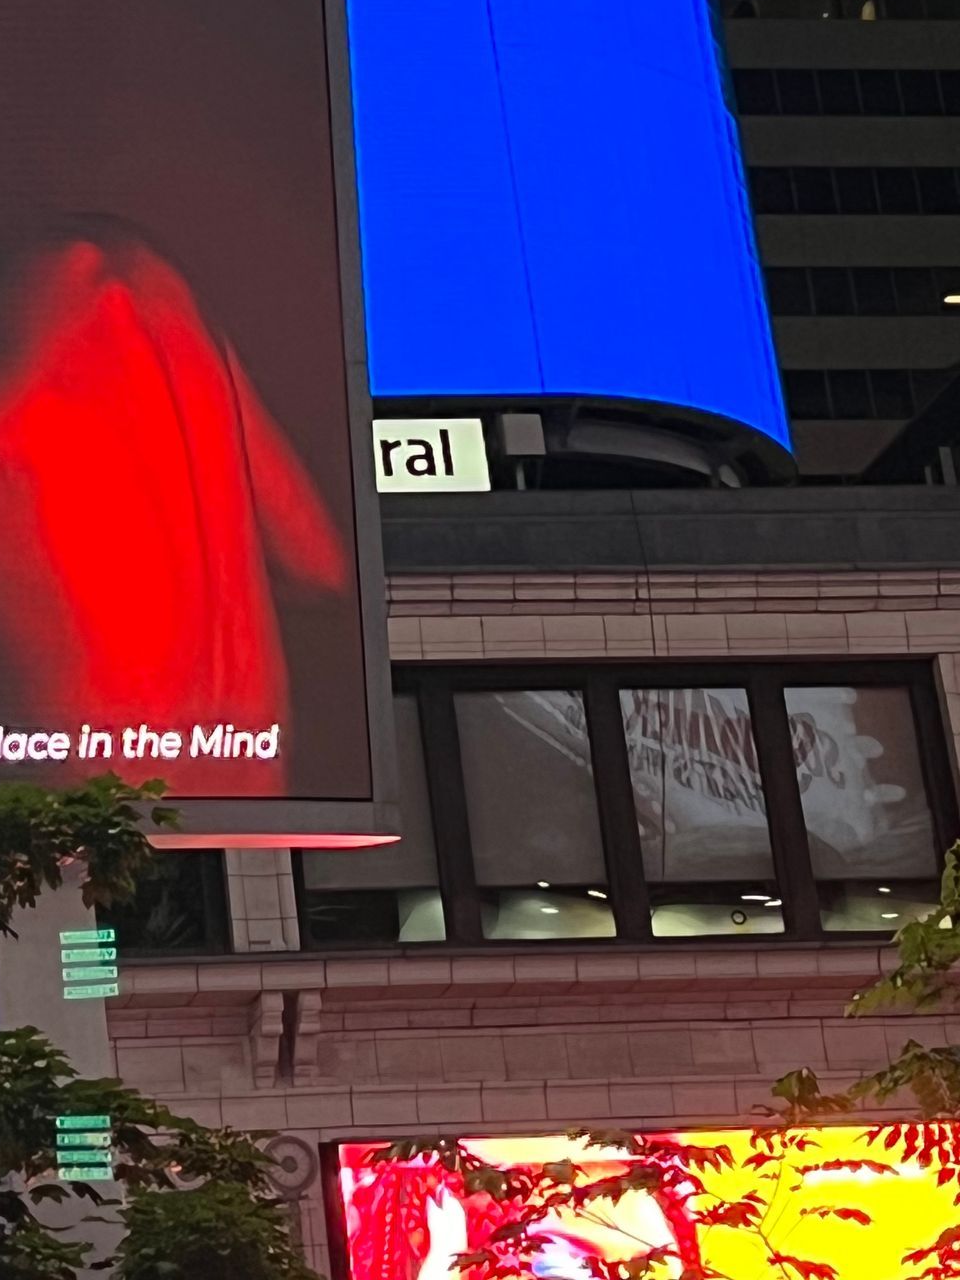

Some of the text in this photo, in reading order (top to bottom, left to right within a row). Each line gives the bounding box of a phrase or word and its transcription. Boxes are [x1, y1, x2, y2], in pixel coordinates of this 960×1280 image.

[379, 428, 454, 477] ral
[78, 723, 113, 759] in
[121, 723, 183, 759] the
[189, 723, 280, 760] Mind
